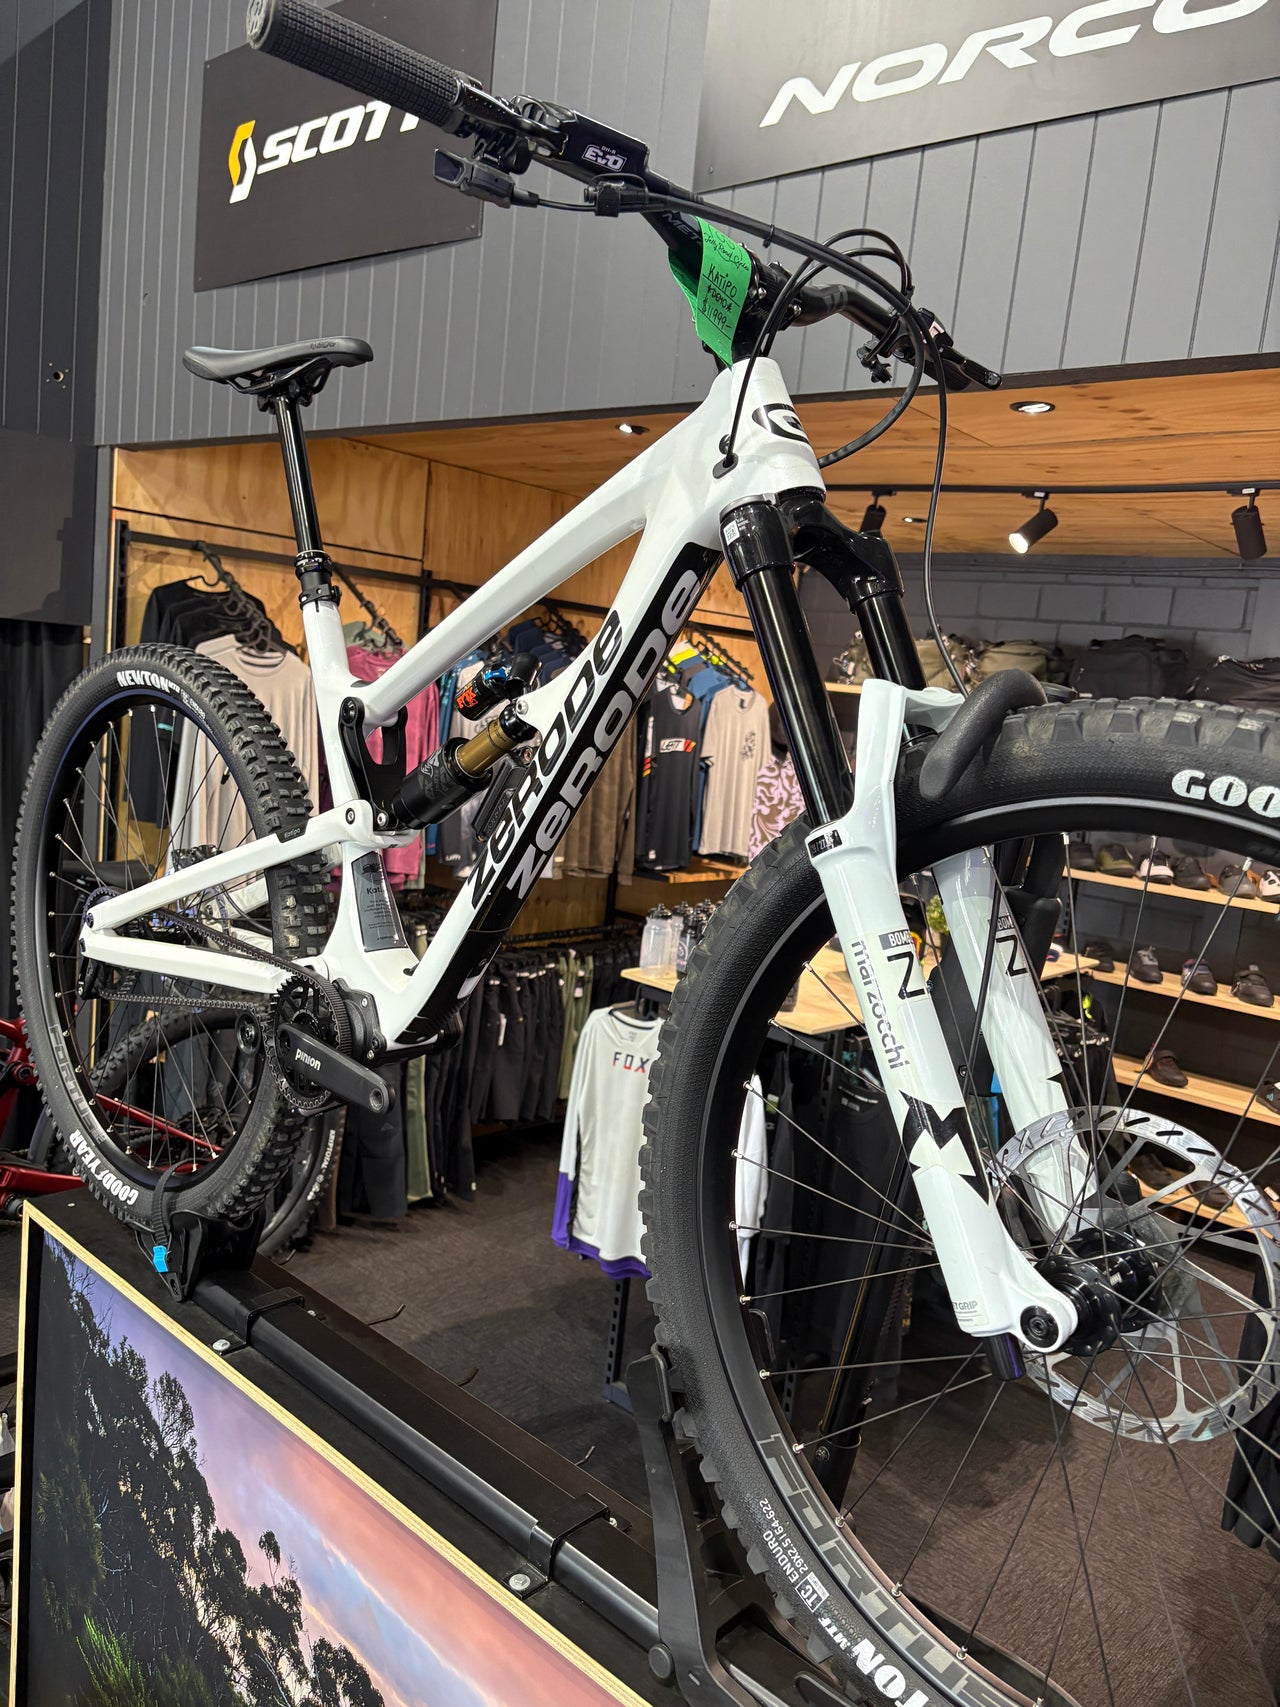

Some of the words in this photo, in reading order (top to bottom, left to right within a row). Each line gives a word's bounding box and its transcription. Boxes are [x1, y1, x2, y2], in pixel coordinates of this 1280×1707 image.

[116, 669, 170, 694] NEWTON
[851, 936, 910, 1070] marzocchi
[294, 1048, 321, 1071] pinion
[612, 1051, 650, 1074] FOX
[69, 1128, 139, 1206] GOODYEAR
[762, 1530, 800, 1584] ENDURO
